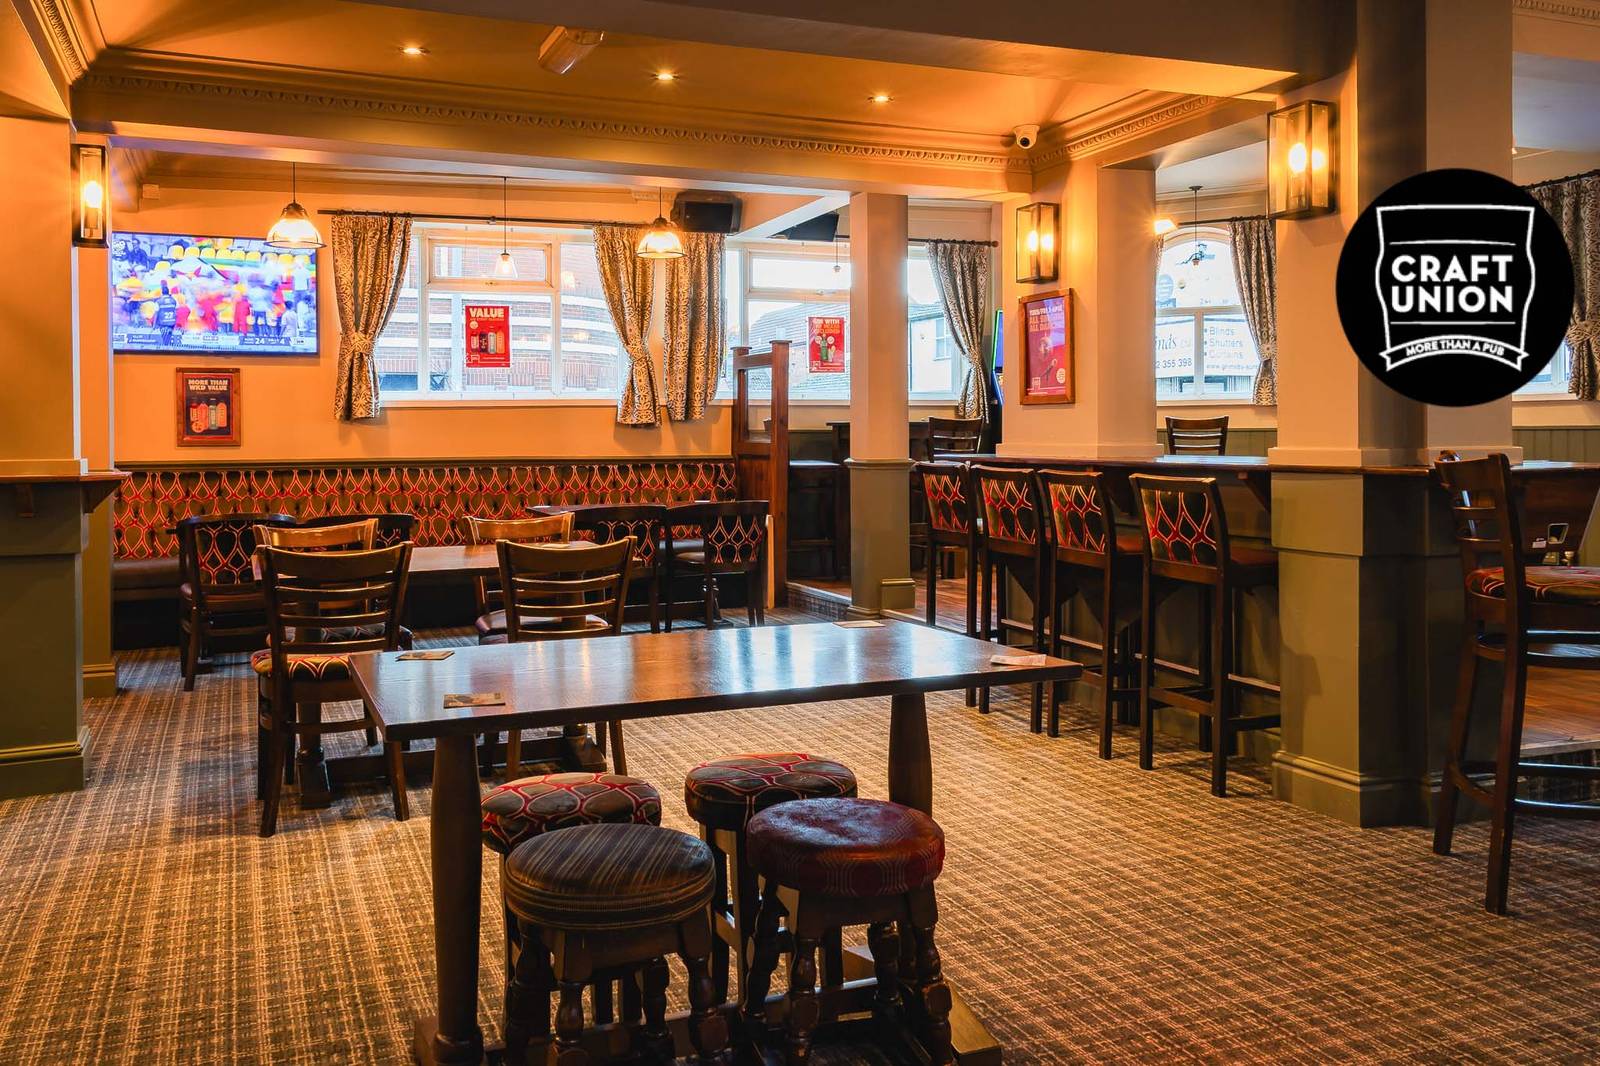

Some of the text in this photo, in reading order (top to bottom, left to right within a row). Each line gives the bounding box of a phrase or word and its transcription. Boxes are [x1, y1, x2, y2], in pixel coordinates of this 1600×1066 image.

[469, 308, 504, 318] VALUE
[1209, 326, 1235, 336] Blinds
[1209, 338, 1243, 347] Shutters
[1162, 360, 1176, 368] 355
[1178, 358, 1192, 367] 398
